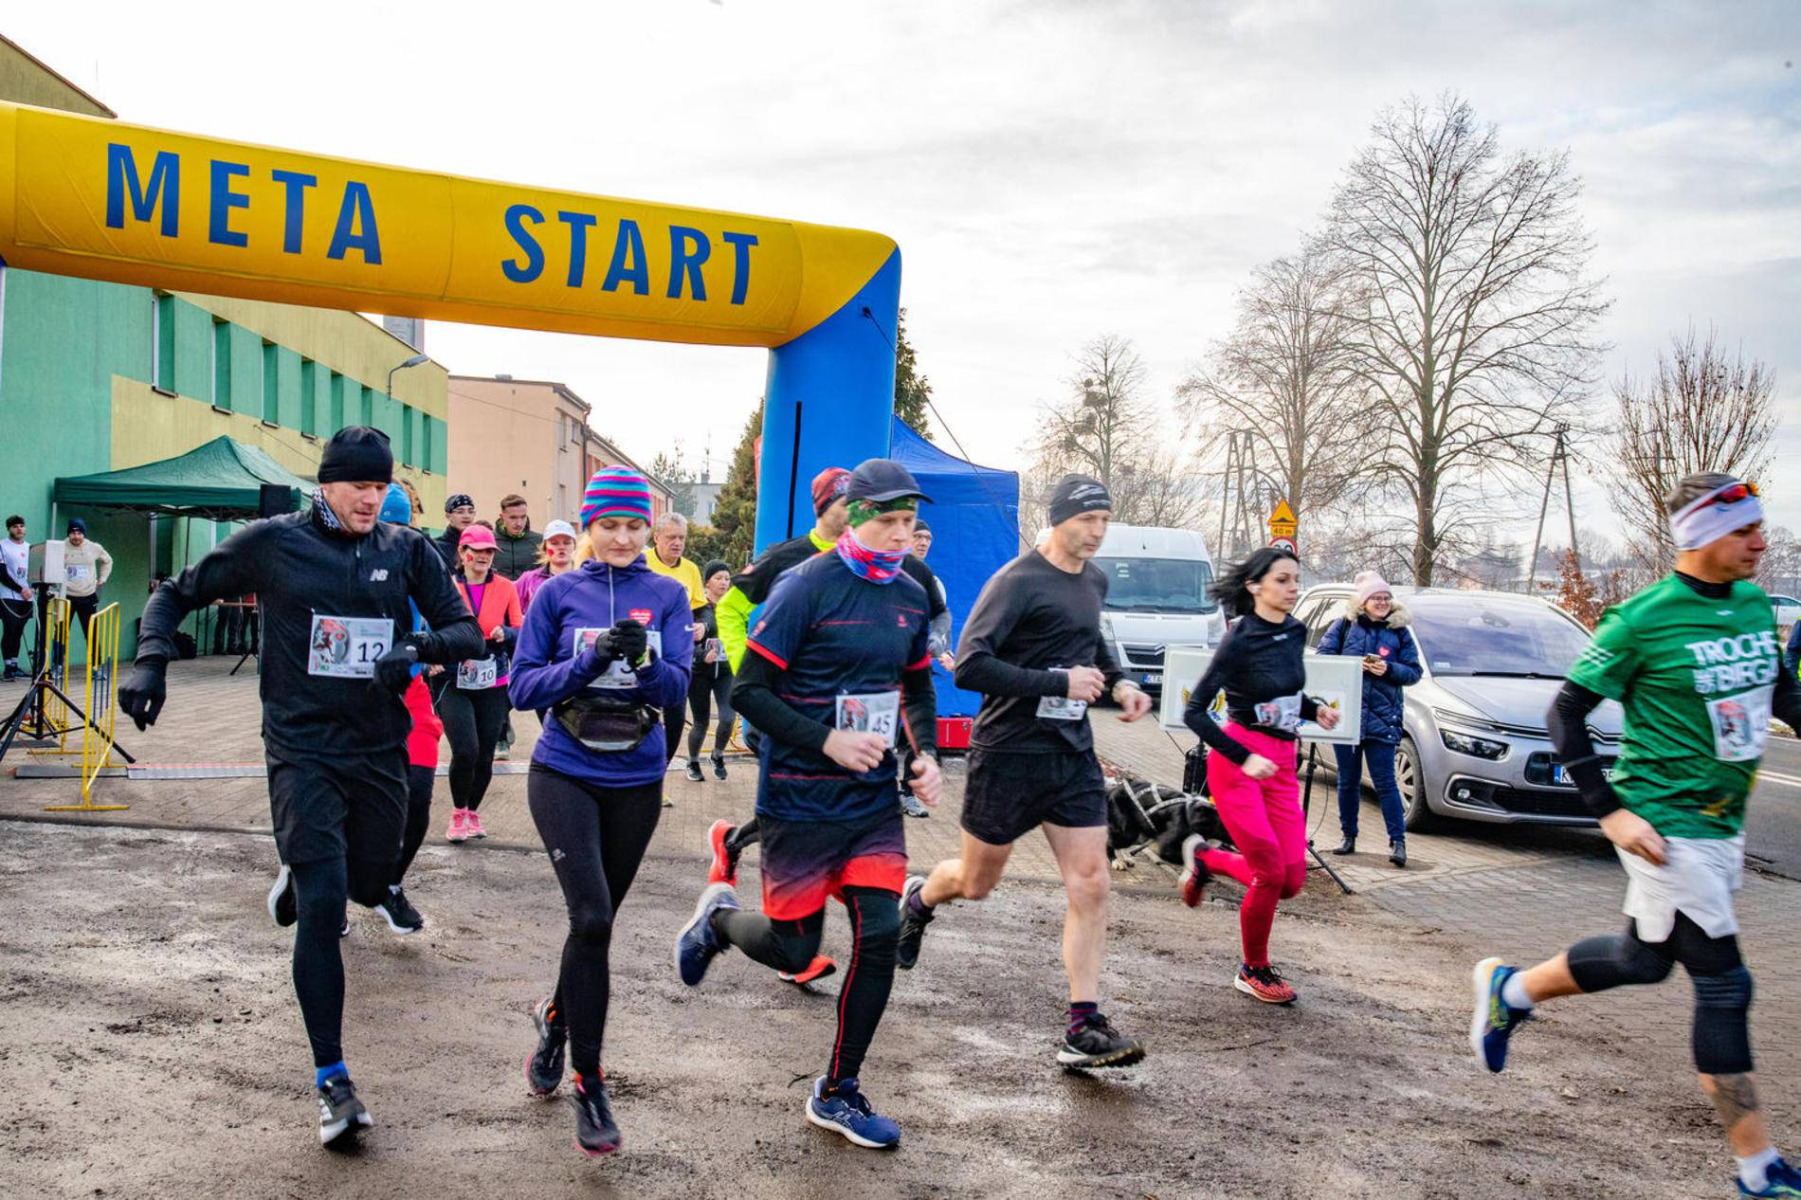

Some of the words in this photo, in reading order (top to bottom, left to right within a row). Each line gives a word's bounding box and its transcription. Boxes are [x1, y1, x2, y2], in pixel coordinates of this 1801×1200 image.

[106, 142, 382, 266] META
[501, 203, 759, 306] START
[357, 641, 384, 663] 12
[481, 668, 494, 682] 10
[871, 714, 891, 735] 45
